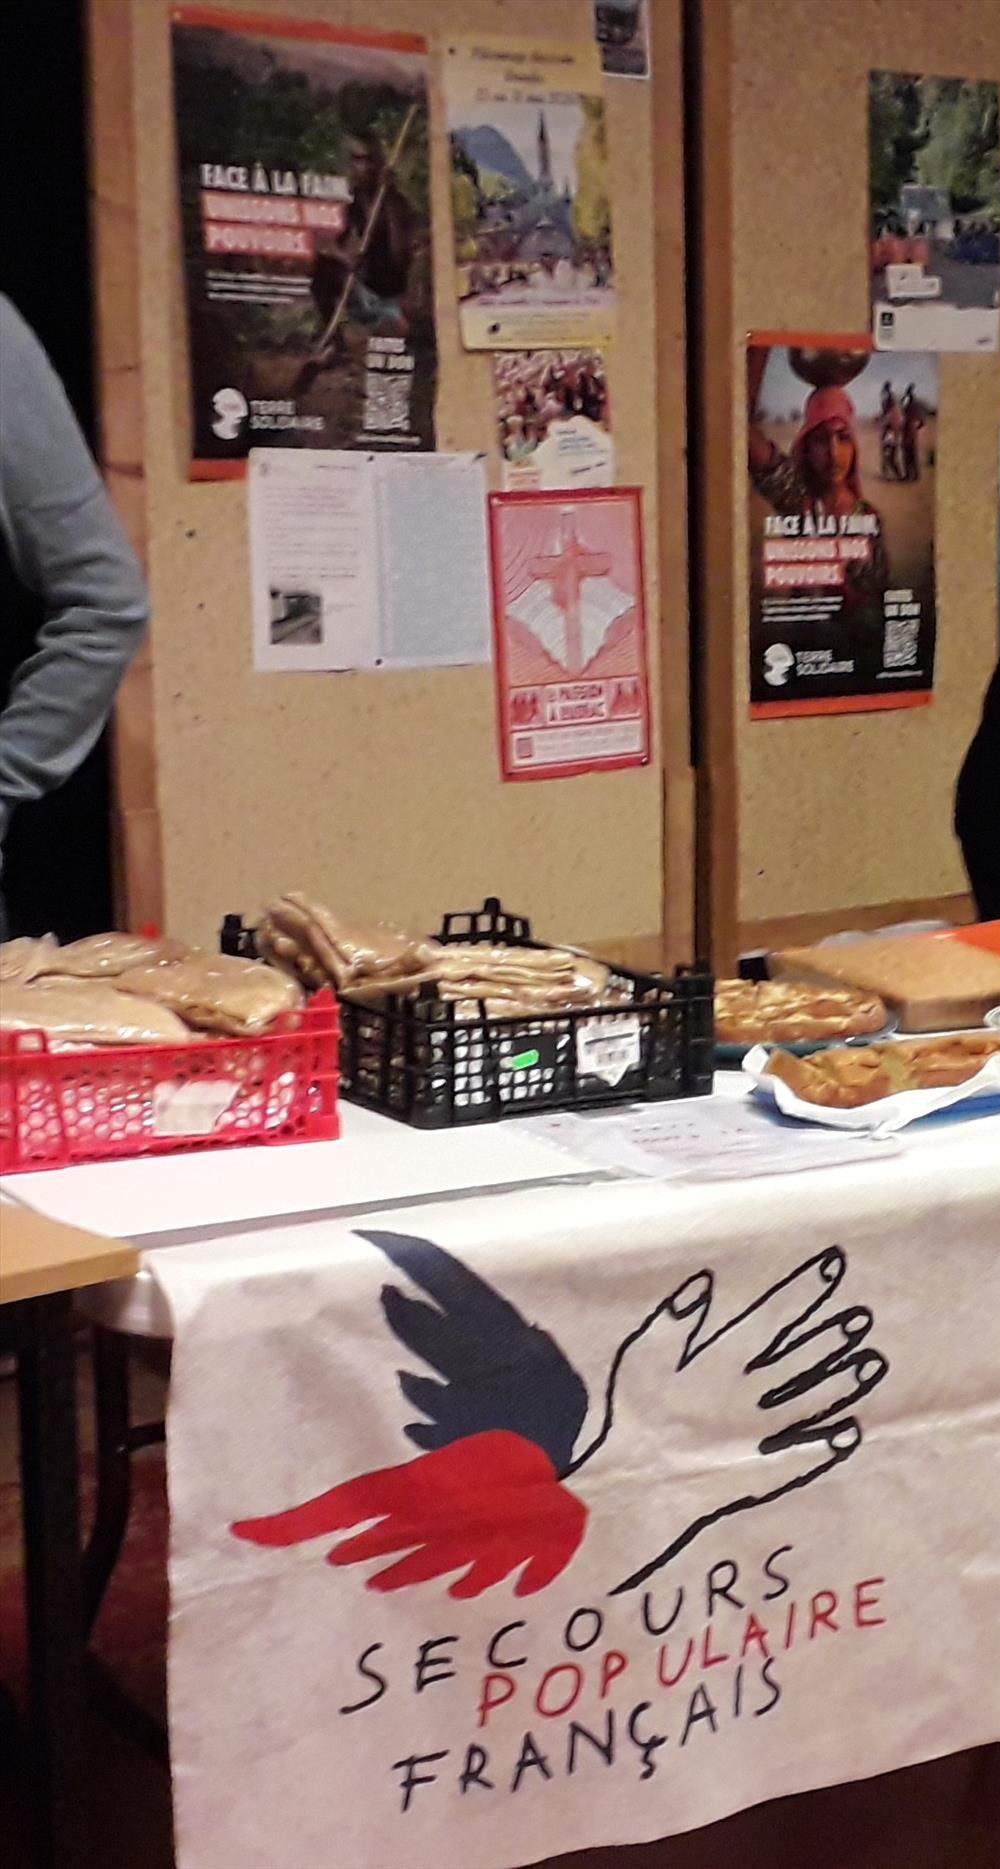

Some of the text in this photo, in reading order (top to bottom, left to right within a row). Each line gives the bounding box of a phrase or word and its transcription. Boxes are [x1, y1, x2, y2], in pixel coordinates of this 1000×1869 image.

[201, 163, 249, 190] FACE
[271, 169, 299, 196] LA
[764, 514, 800, 537] FACE
[817, 513, 838, 536] LA
[339, 1545, 794, 1714] SECOURS
[476, 1577, 887, 1729] POPULAIRE
[392, 1656, 782, 1813] FRANÇAIS
